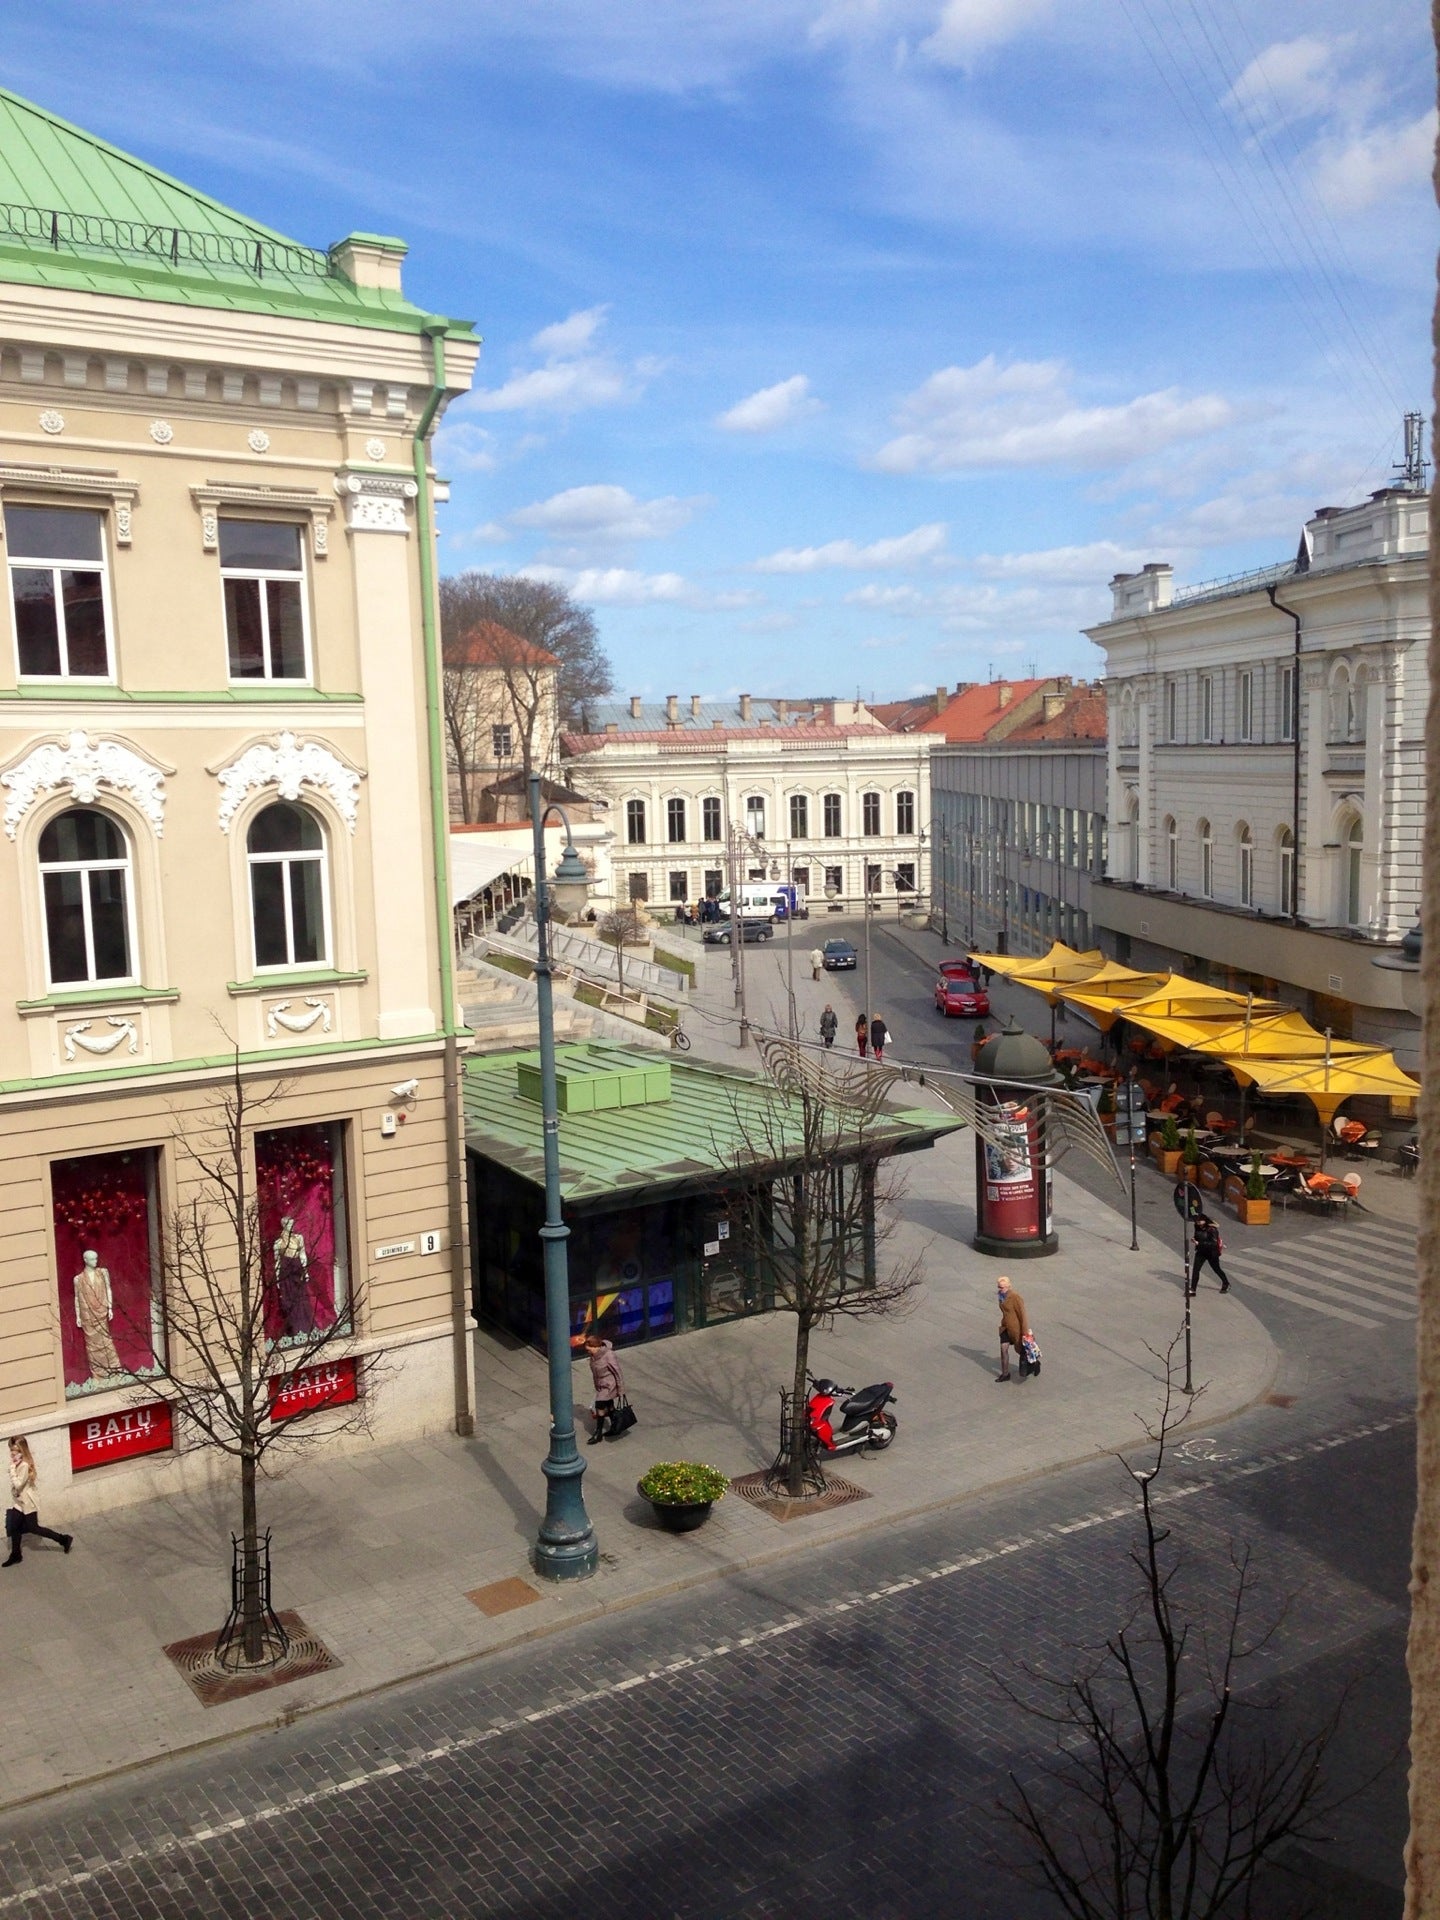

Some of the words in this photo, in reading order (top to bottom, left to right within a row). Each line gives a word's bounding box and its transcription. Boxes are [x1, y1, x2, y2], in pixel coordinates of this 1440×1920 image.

[428, 1236, 434, 1250] 9
[282, 1383, 338, 1403] CENTRAS
[87, 1429, 151, 1450] CENTRAS
